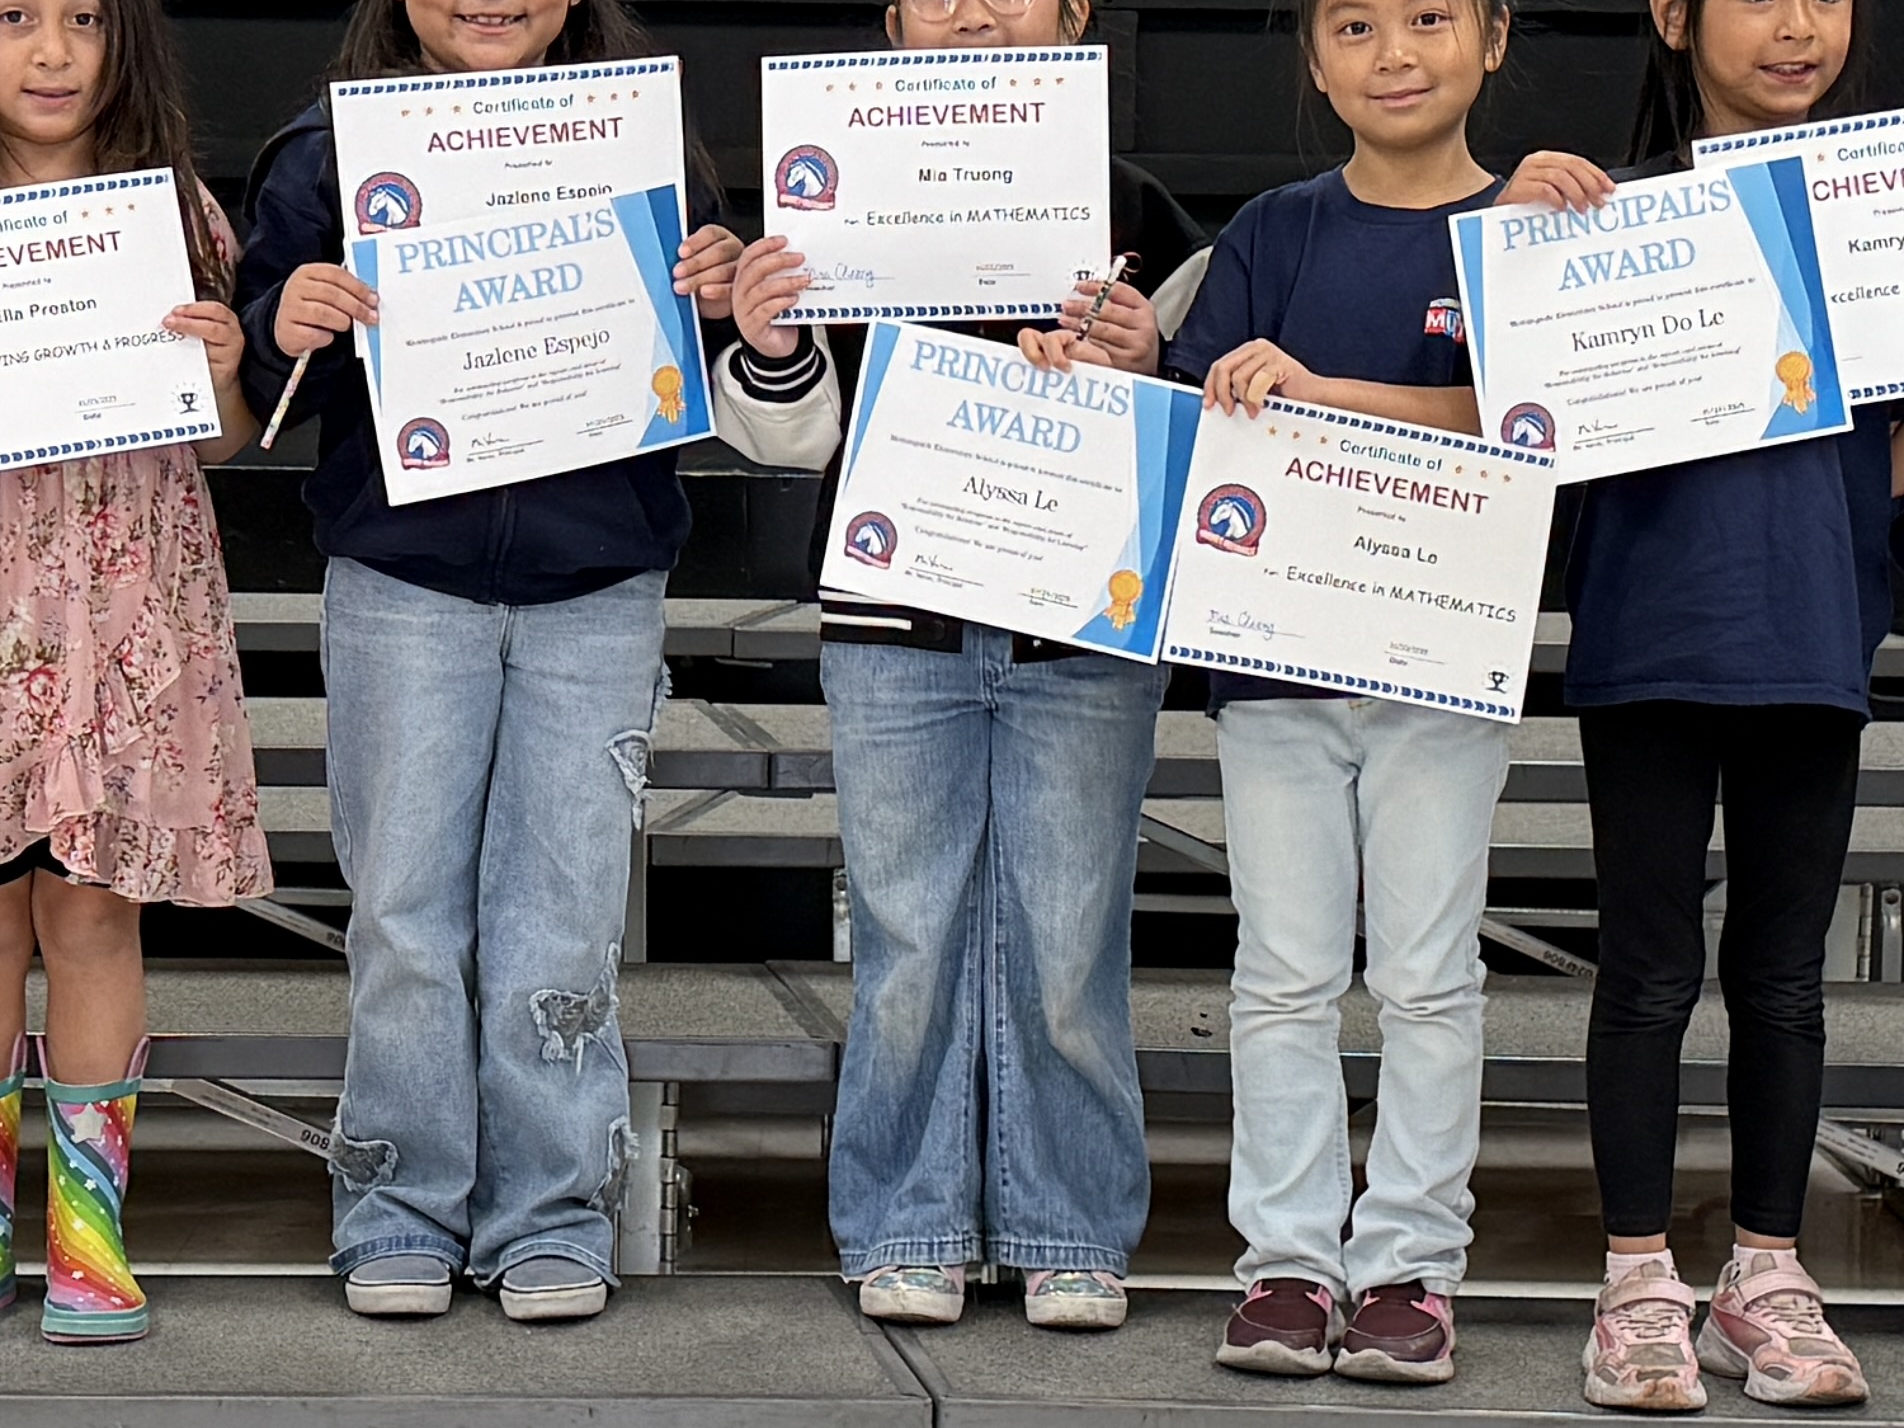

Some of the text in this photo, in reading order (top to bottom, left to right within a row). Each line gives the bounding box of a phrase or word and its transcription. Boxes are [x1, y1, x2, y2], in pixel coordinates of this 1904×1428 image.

[895, 76, 996, 92] Certificate of
[473, 94, 573, 114] Certificate of
[848, 102, 1045, 128] ACHIEVEMENT
[428, 117, 623, 153] ACHIEVEMENT
[919, 168, 1013, 184] Mia Truong
[53, 210, 67, 224] of
[867, 211, 944, 226] Excellence
[950, 211, 962, 222] in
[967, 207, 1090, 222] MATHEMATICS
[1500, 174, 1731, 251] PRINCIPAL'S
[395, 205, 615, 274] PRINCIPAL'S
[1558, 238, 1696, 291] AWARD
[453, 263, 583, 313] AWARD
[1831, 285, 1900, 303] xcellence
[34, 341, 98, 361] GROWTH
[463, 330, 610, 370] Jazlene Espejo
[1572, 324, 1655, 352] Kamryn
[1662, 315, 1692, 334] Do
[910, 340, 1134, 416] PRINCIPAL'S
[946, 400, 1081, 453] AWARD
[1340, 439, 1442, 471] Certificate of
[962, 476, 1027, 505] Alyssa
[1285, 457, 1489, 514] ACHIEVEMENT
[1287, 566, 1366, 593] Excellence
[1372, 582, 1385, 596] in
[1390, 586, 1516, 622] MATHEMATICS
